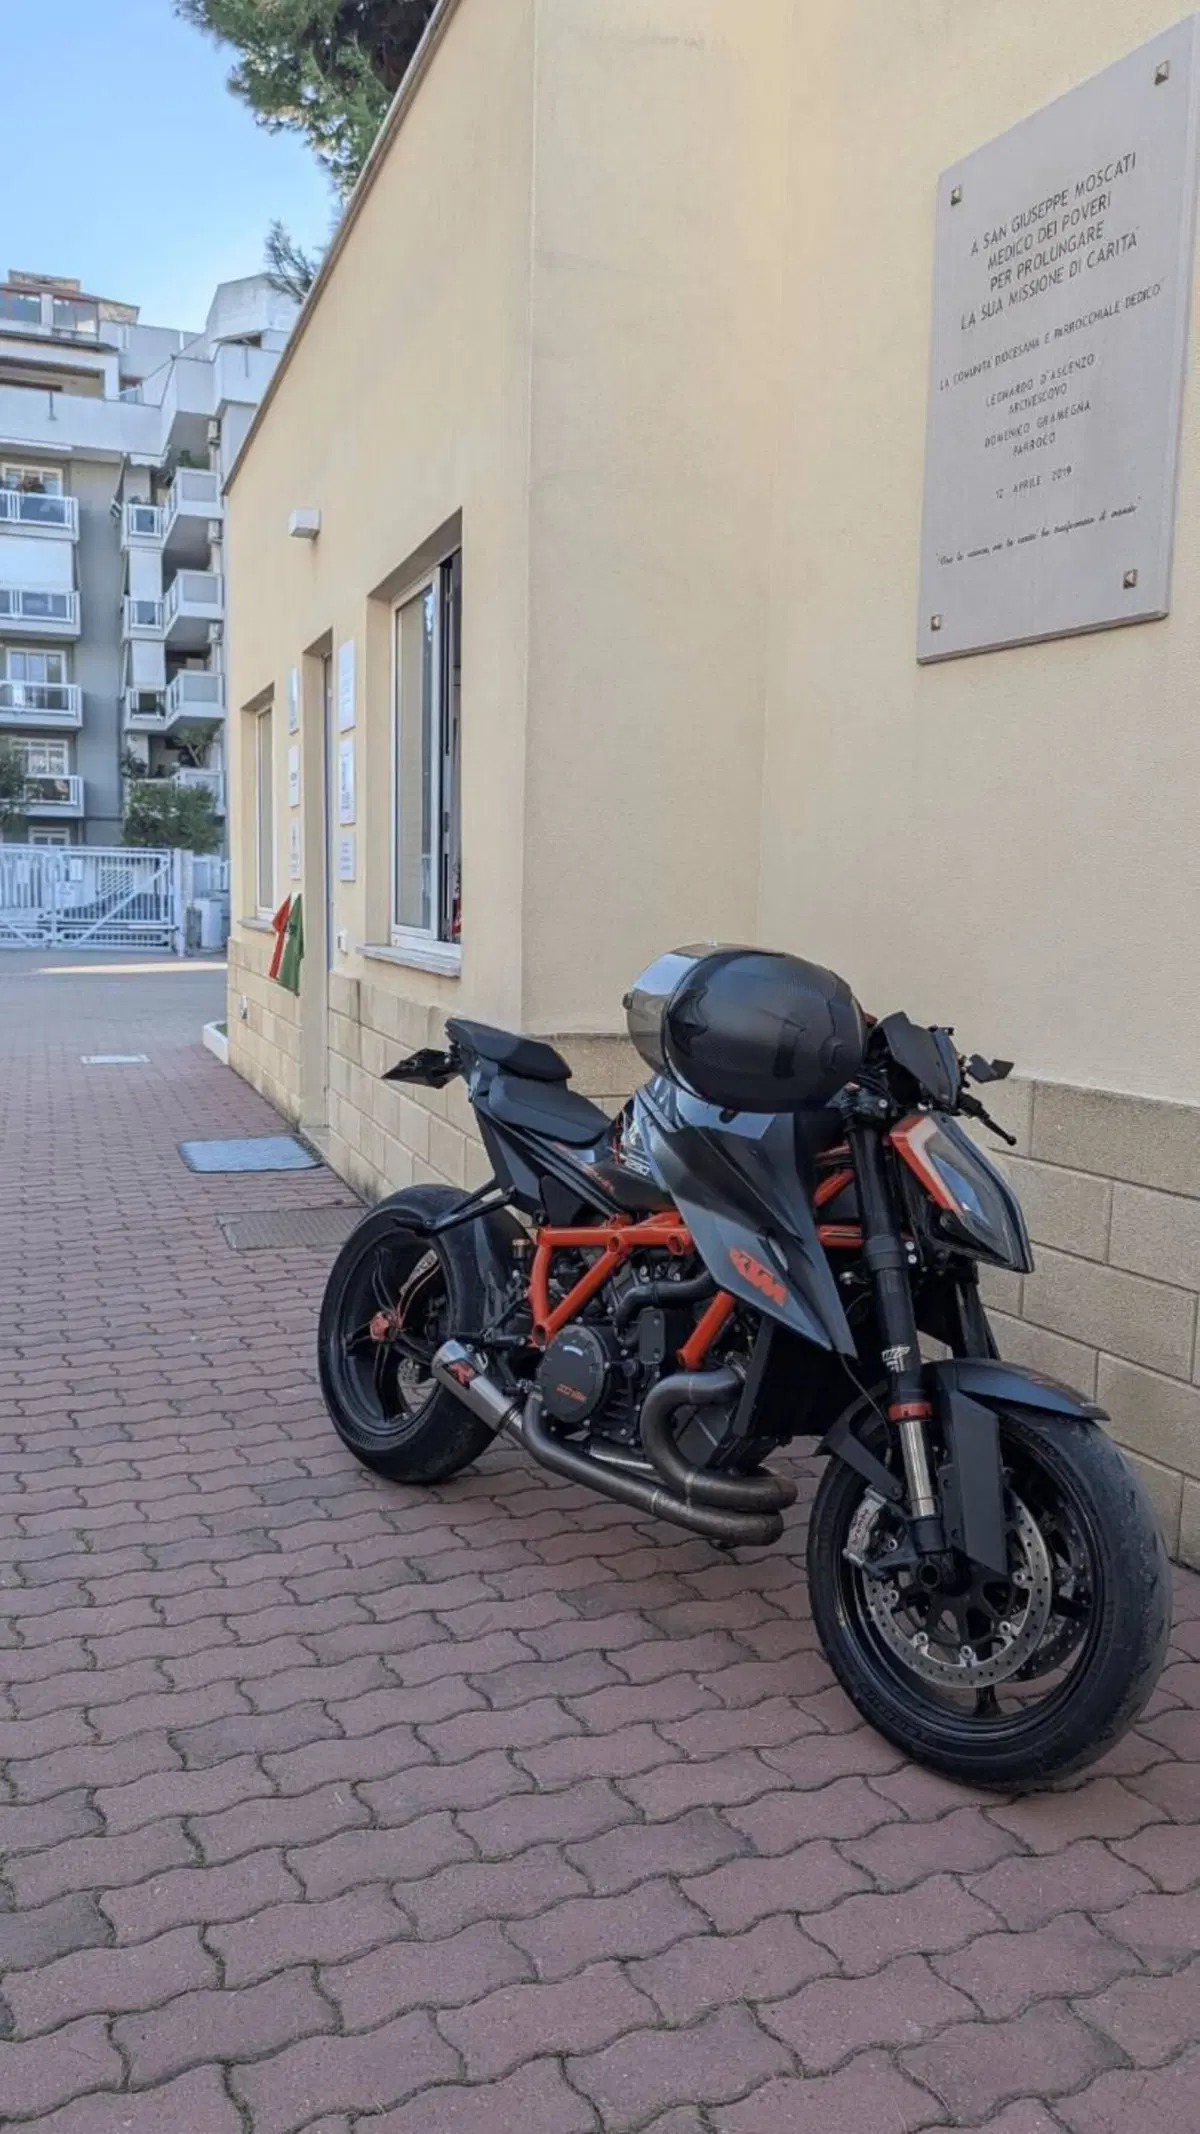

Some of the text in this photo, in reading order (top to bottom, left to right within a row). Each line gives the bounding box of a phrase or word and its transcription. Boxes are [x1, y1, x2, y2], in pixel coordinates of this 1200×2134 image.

[970, 151, 1137, 257] A SAN GIUSEPPE MOSCATI
[986, 190, 1112, 270] MEDICO DEI POVERI
[989, 219, 1105, 293] PER PROLUNGARE
[960, 311, 977, 331] LA
[980, 297, 1004, 322] SUA
[1008, 265, 1065, 307] MISSIONE
[1068, 259, 1082, 279] DI
[1044, 332, 1052, 345] E
[984, 422, 1031, 448] DOMENICO
[1012, 475, 1042, 493] APRILE
[729, 1247, 788, 1305] KTM
